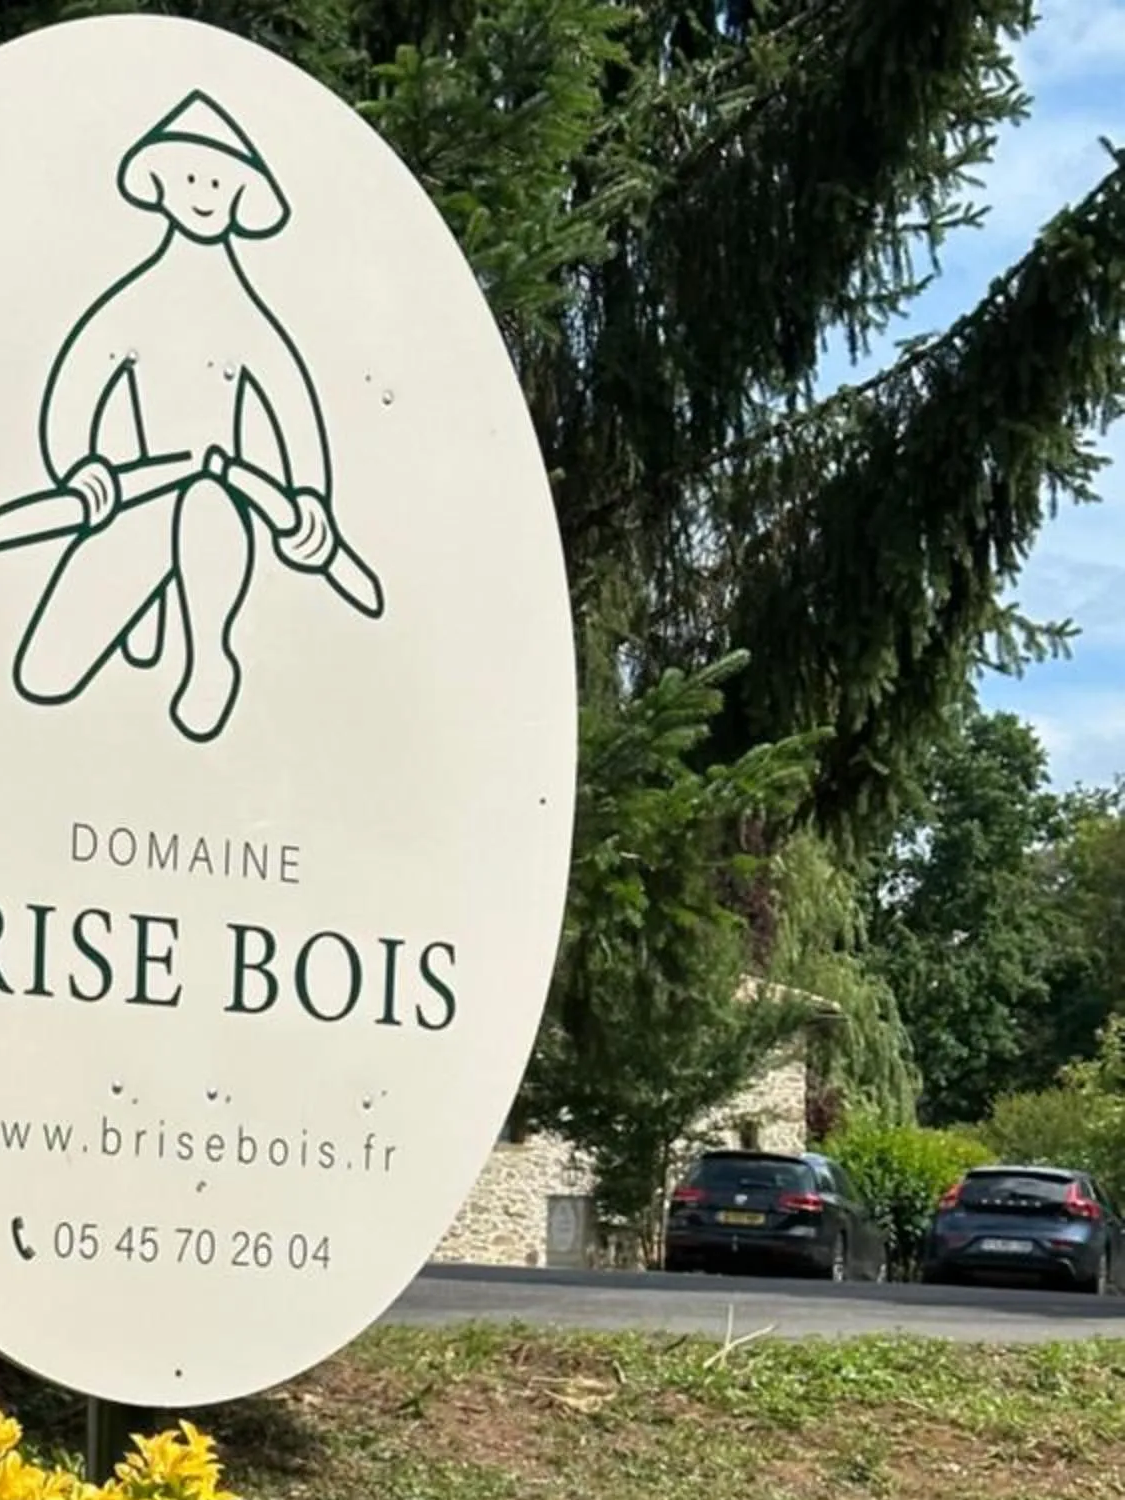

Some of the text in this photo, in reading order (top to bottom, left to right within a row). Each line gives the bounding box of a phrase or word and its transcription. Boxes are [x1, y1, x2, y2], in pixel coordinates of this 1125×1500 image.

[71, 821, 301, 885] DOMAINE
[222, 922, 458, 1032] BOIS
[52, 1220, 332, 1271] 05 45 70 26 04
